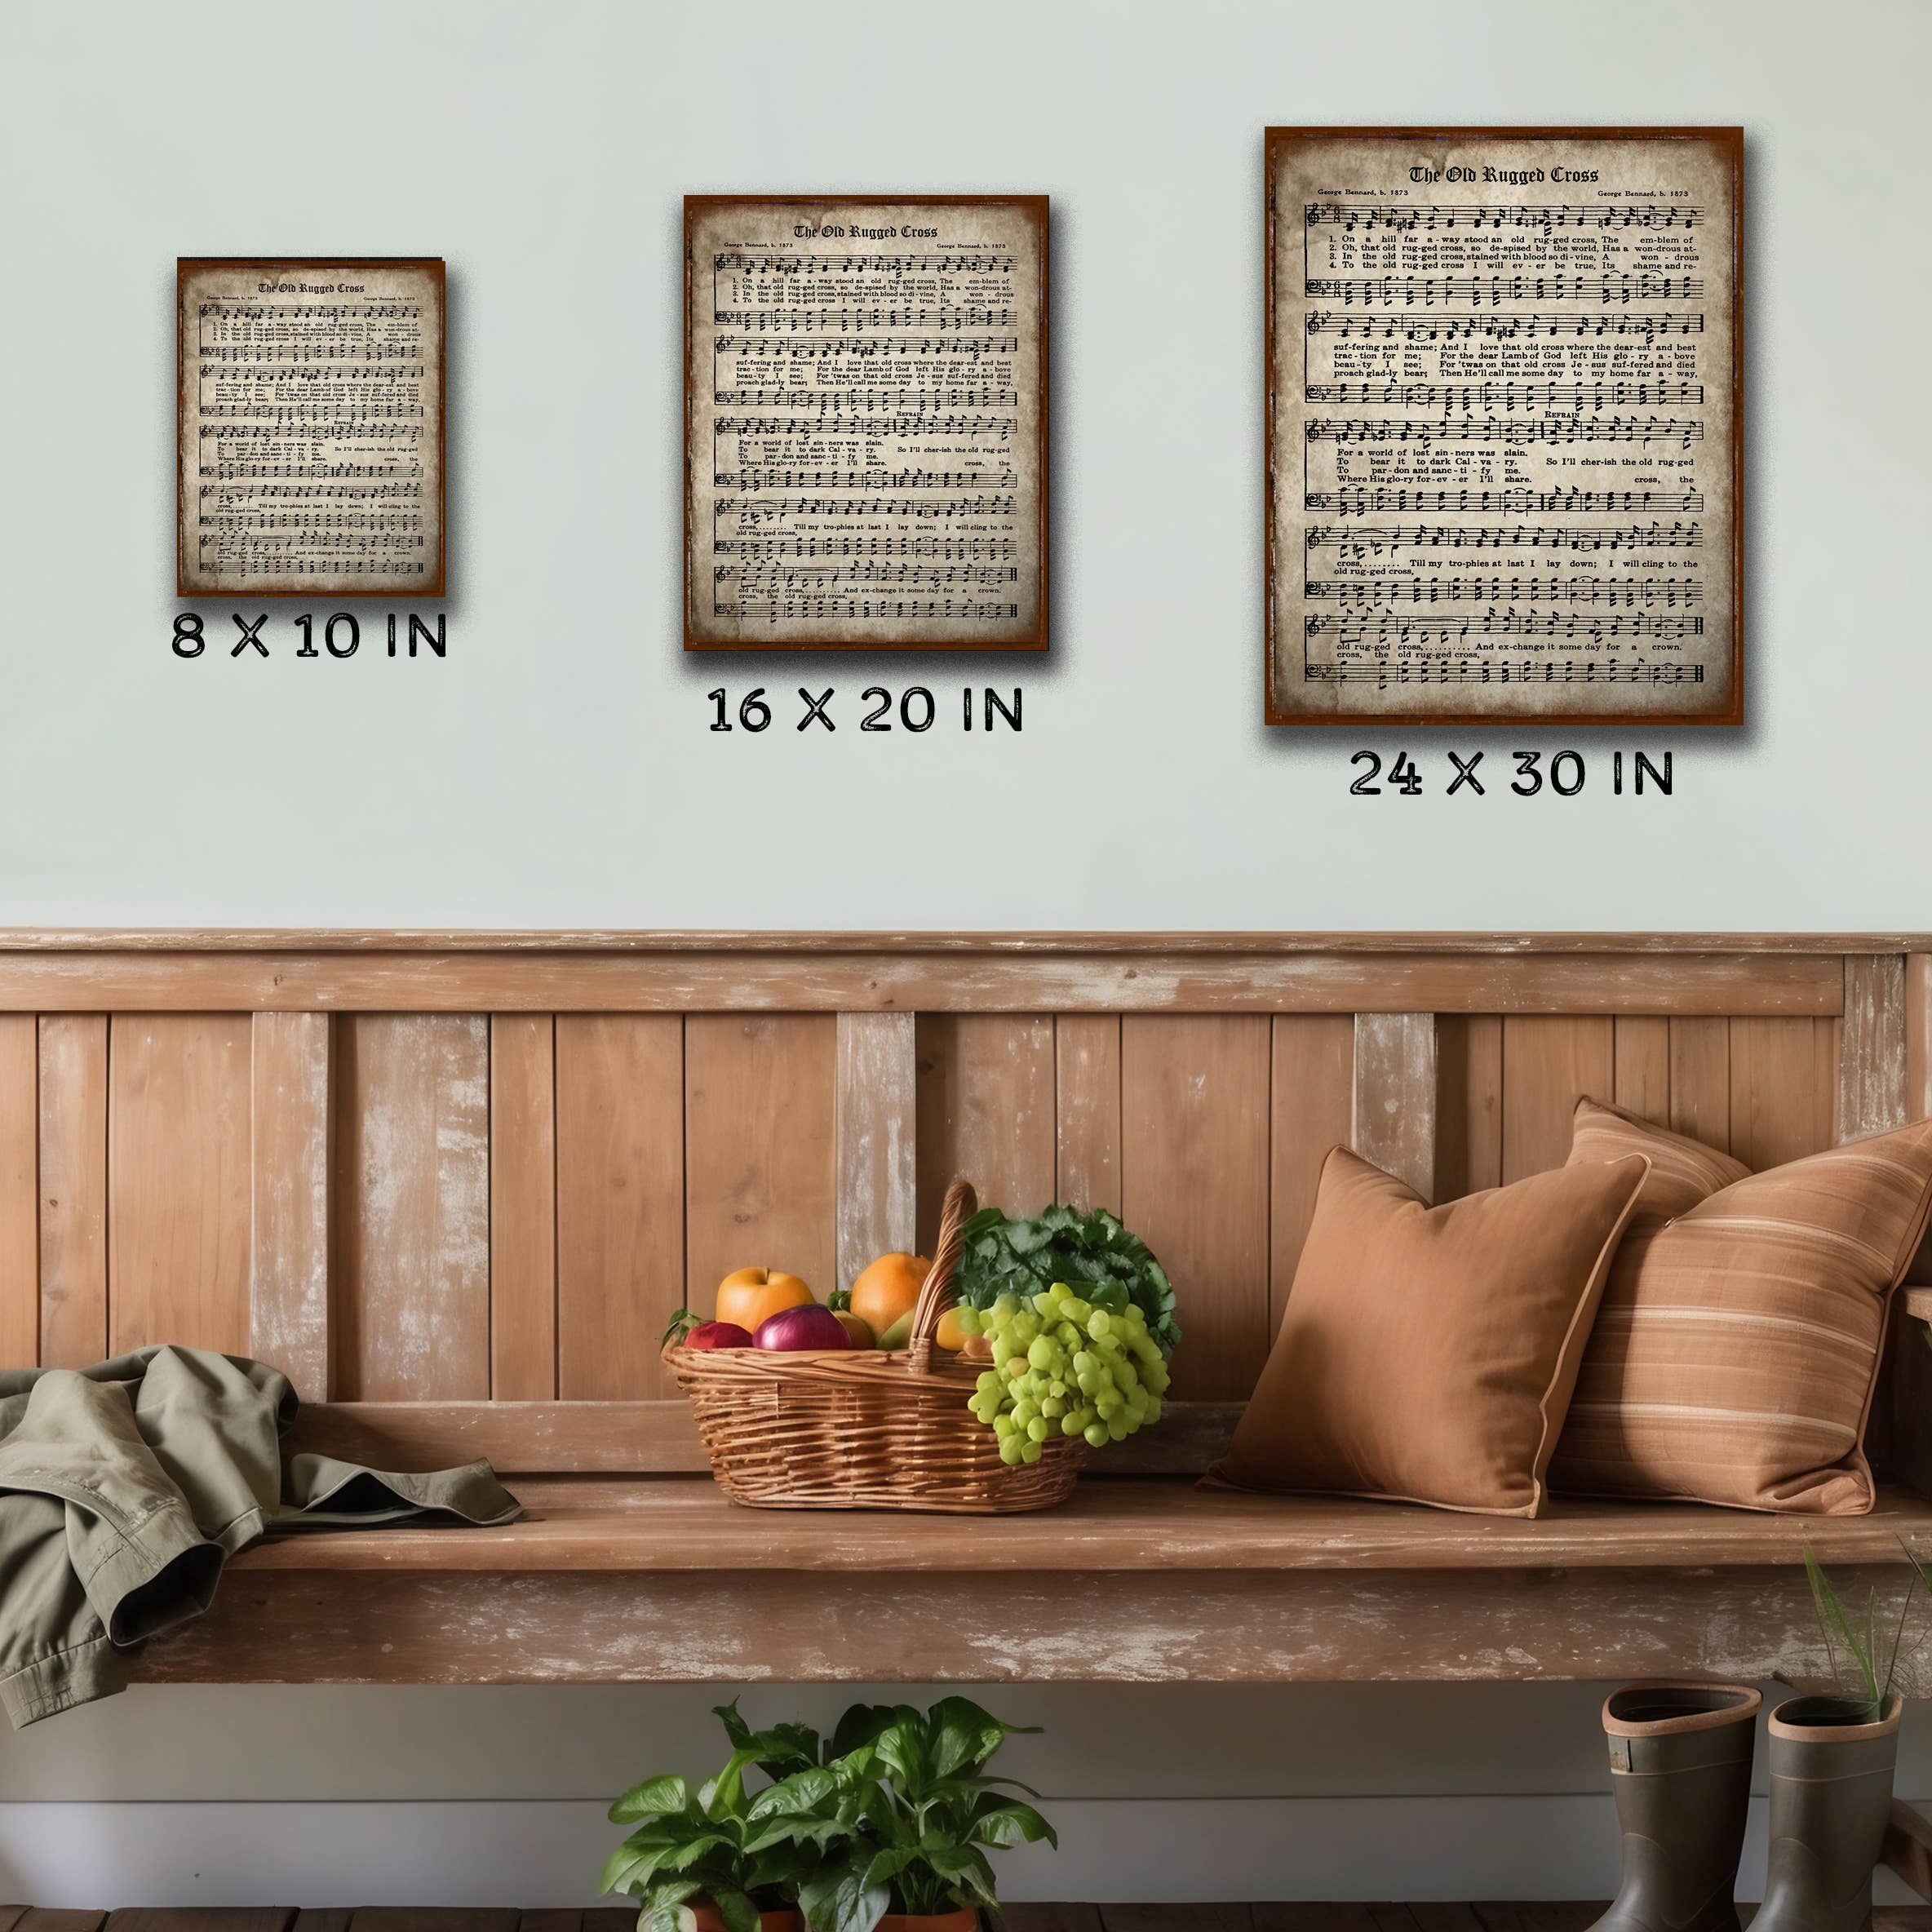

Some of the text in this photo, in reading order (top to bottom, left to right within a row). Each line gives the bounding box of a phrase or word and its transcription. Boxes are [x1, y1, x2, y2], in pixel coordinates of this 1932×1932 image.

[1410, 166, 1599, 185] The Old Rugged Cross
[1318, 188, 1342, 197] George
[794, 225, 938, 240] The Old Rugged Cross
[1342, 244, 1358, 252] Oh,
[1535, 244, 1547, 252] by
[258, 283, 365, 294] The Old Rugged Cross
[1405, 343, 1437, 352] shame;
[1547, 560, 1561, 568] lay
[1570, 560, 1597, 568] down;
[1642, 560, 1664, 568] cling
[1584, 642, 1602, 652] day
